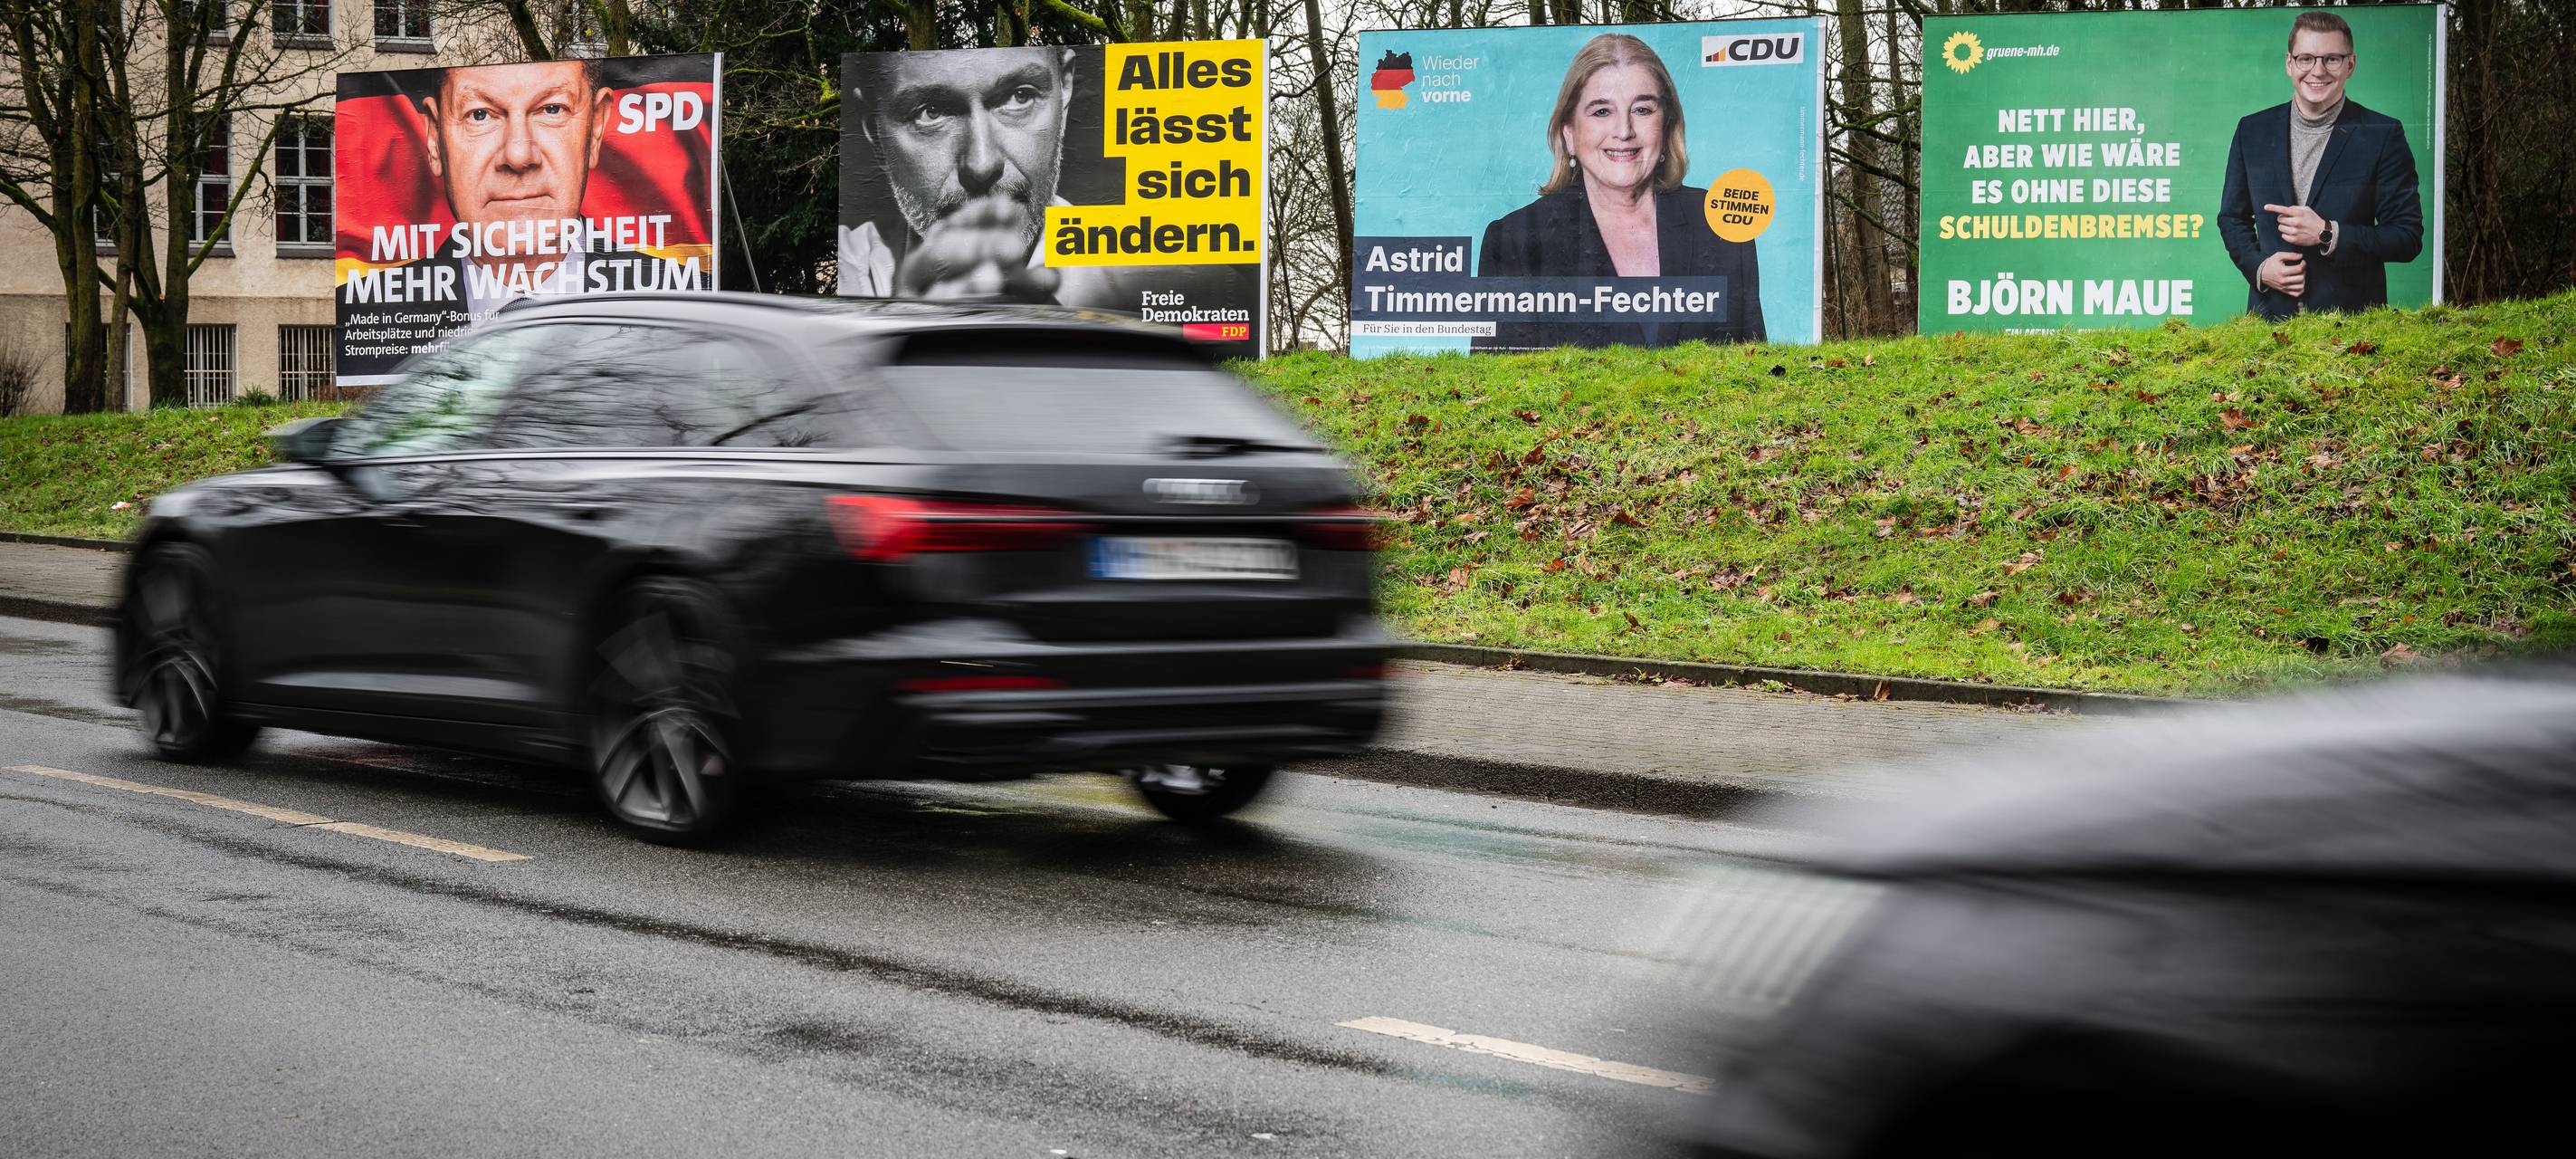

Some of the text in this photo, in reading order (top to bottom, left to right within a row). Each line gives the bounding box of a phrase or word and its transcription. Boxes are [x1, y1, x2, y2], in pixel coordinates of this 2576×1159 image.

[1728, 38, 1800, 62] CDU
[1987, 44, 2060, 61] gruene-mh.de
[1117, 52, 1252, 91] Alles
[1422, 55, 1479, 71] Wieder
[1422, 72, 1461, 87] nach
[1422, 91, 1471, 102] vorne
[616, 91, 703, 133] SPD
[1999, 108, 2145, 135] NETT HIER,
[1116, 105, 1252, 145] lässt
[1963, 138, 2180, 168] ABER WIE WÄRE
[1137, 159, 1251, 199] sich
[1971, 178, 2171, 204] ES OHNE DIESE
[1723, 188, 1760, 201] BEIDE
[1711, 199, 1769, 215] STIMMEN
[1722, 214, 1753, 225] CDU
[1939, 214, 2204, 239] SCHULDENBREMSE?
[371, 215, 672, 261] MIT SICHERHEIT
[1055, 216, 1255, 255] ändern.
[1365, 244, 1463, 272] Astrid
[346, 266, 457, 304] MEHR
[467, 256, 702, 301] WACHSTUM
[1141, 290, 1185, 306] Freie
[1364, 284, 1720, 312] Timmermann-Fechter
[1948, 273, 2193, 315] BJÖRN MAUE
[382, 310, 392, 323] in
[484, 309, 500, 321] für
[1141, 306, 1249, 322] Demokraten
[345, 328, 412, 342] Arbeitsplätze
[415, 327, 435, 339] und
[1222, 326, 1246, 337] FDP
[1363, 323, 1492, 336] Für Sie in den Bundestag
[345, 344, 408, 359] Strompreise:
